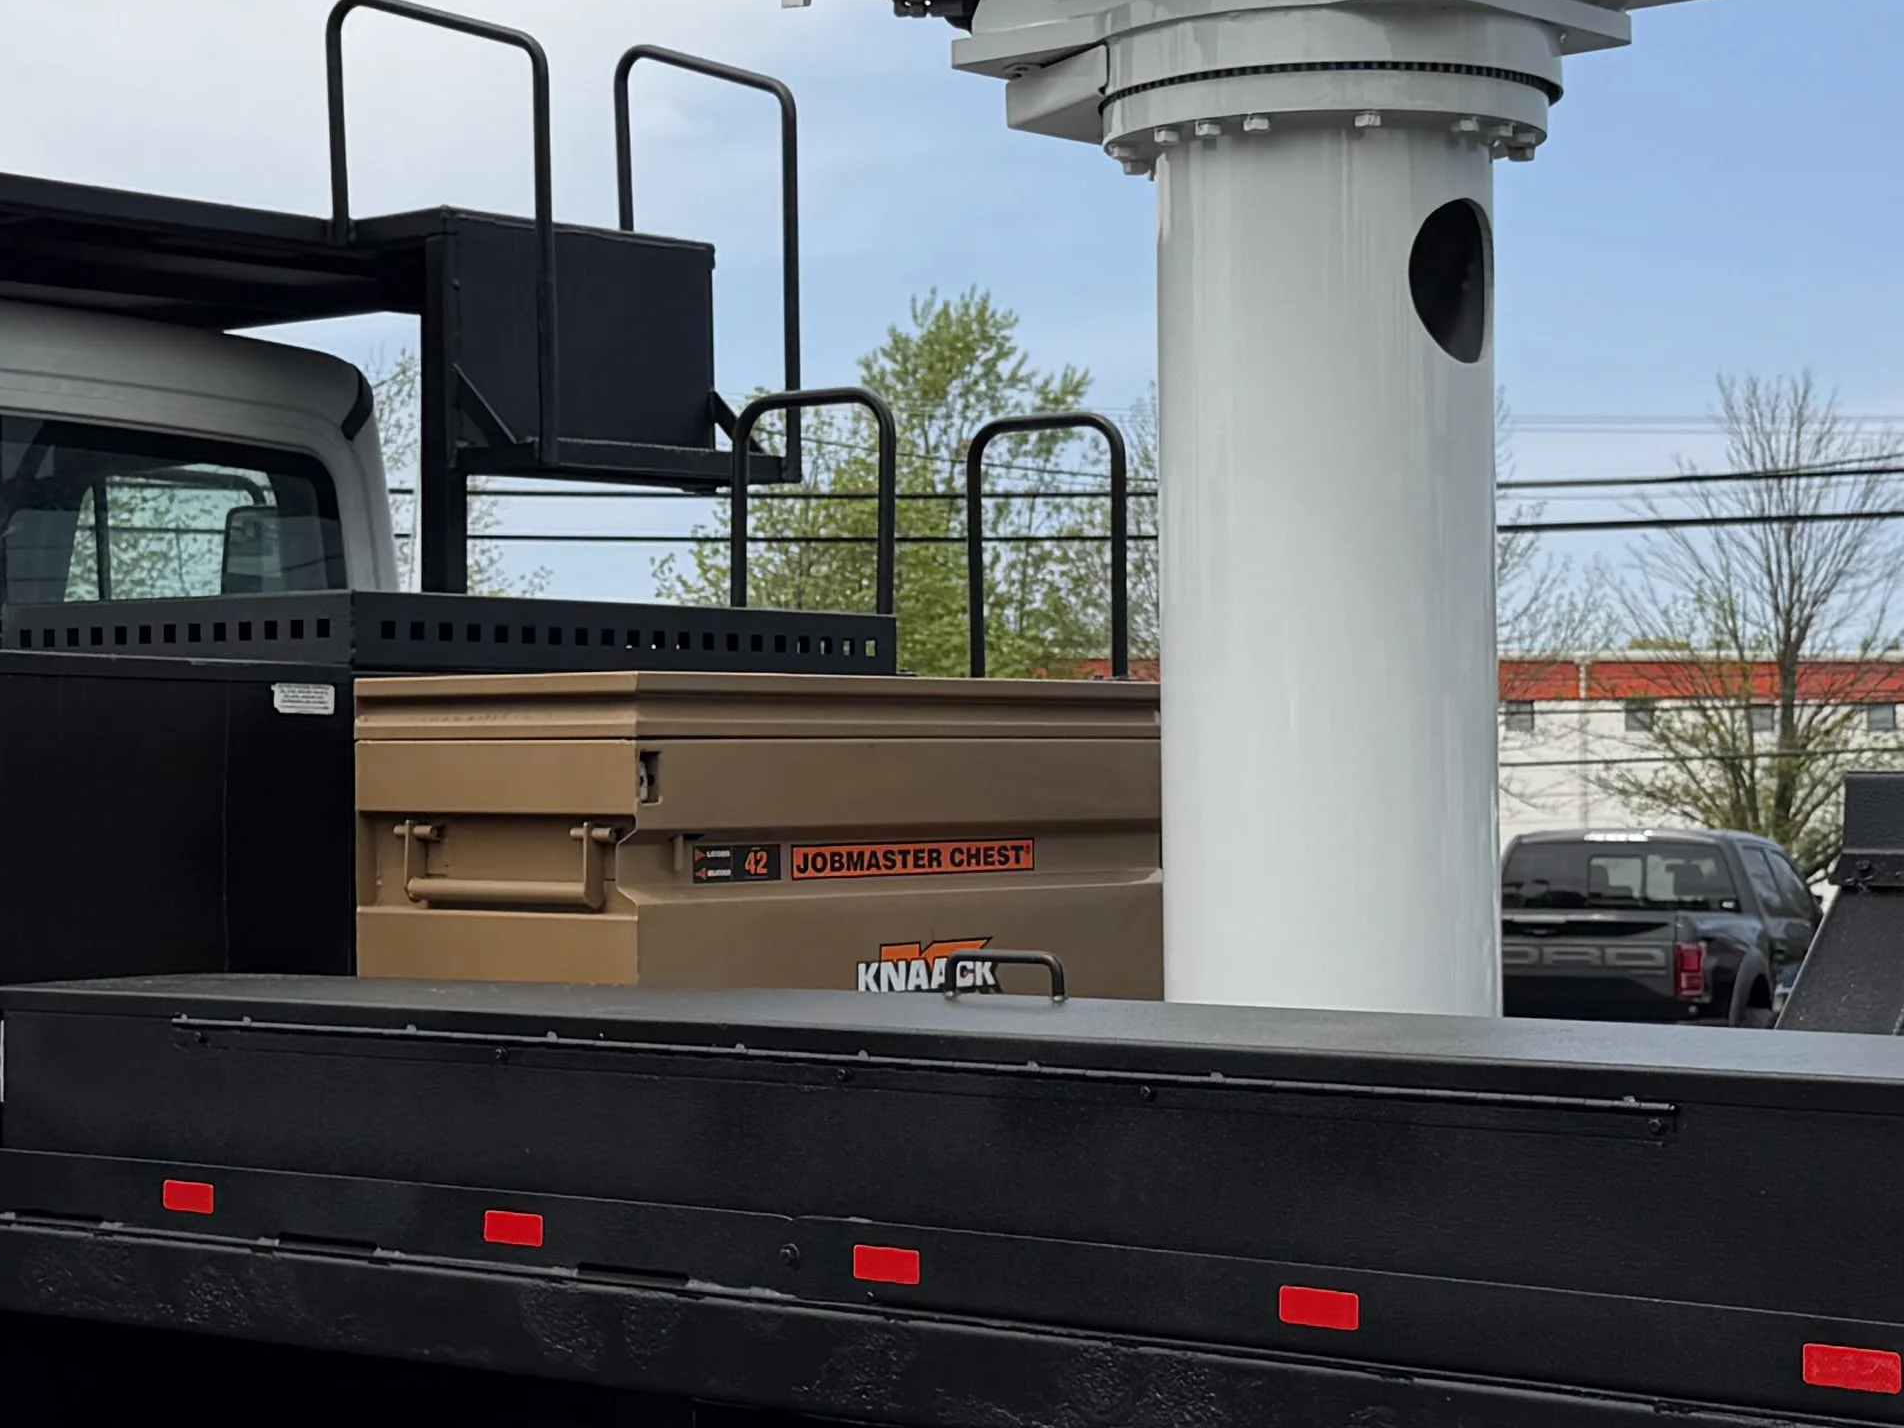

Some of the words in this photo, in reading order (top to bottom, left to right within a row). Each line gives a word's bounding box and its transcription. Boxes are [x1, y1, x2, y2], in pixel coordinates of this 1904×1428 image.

[744, 851, 768, 876] 42
[795, 844, 943, 875] JOBMASTER
[949, 844, 1026, 869] CHEST
[1502, 945, 1667, 968] ORD
[857, 959, 996, 993] KNAACK
